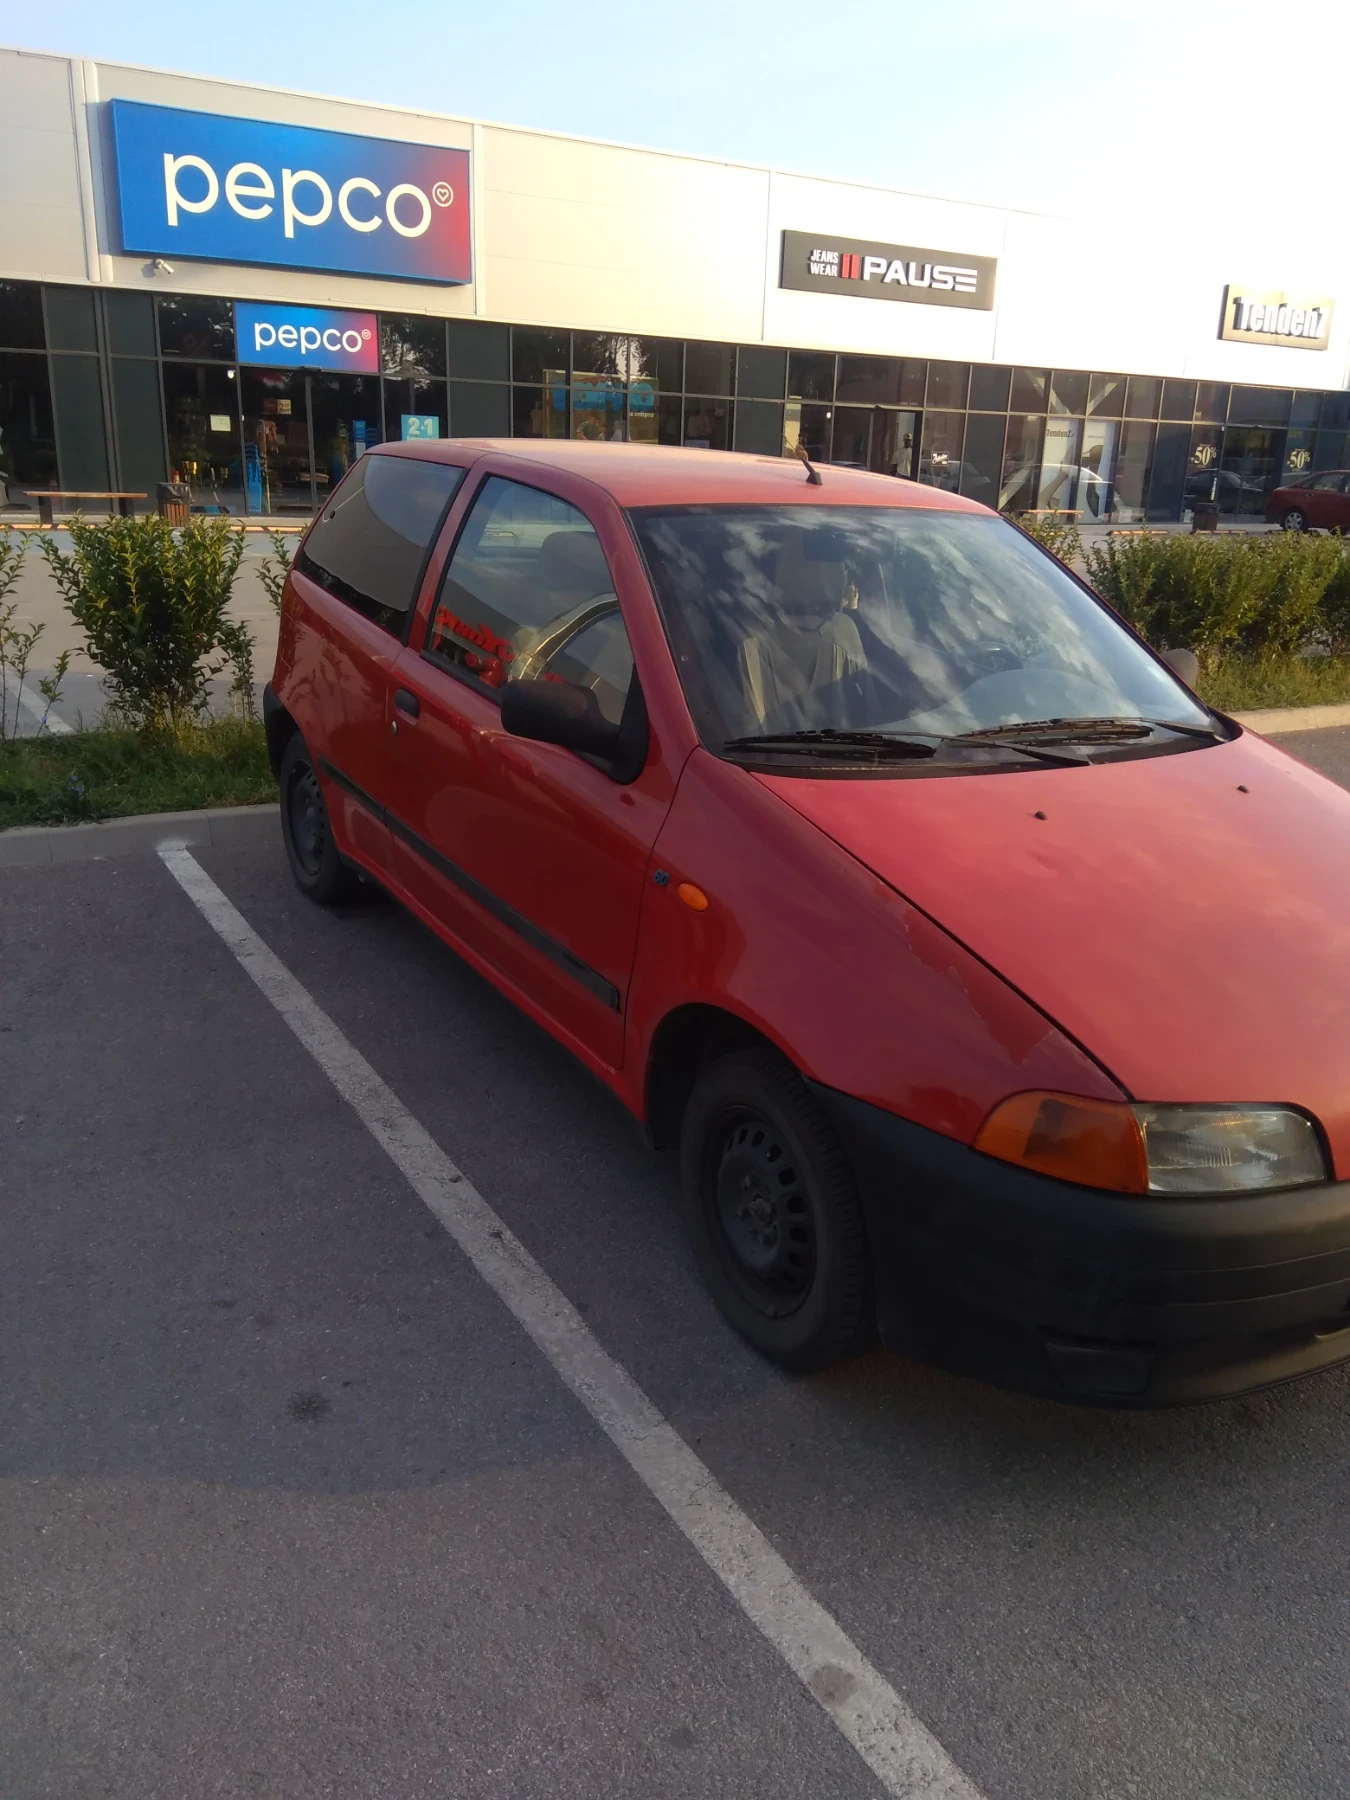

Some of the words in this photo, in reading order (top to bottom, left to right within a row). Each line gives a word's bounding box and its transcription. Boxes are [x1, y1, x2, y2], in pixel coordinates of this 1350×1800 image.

[163, 153, 432, 239] pepco
[809, 262, 838, 277] WEAR
[810, 249, 838, 264] JEANS
[862, 255, 978, 293] PAUSE
[254, 322, 363, 354] pepco
